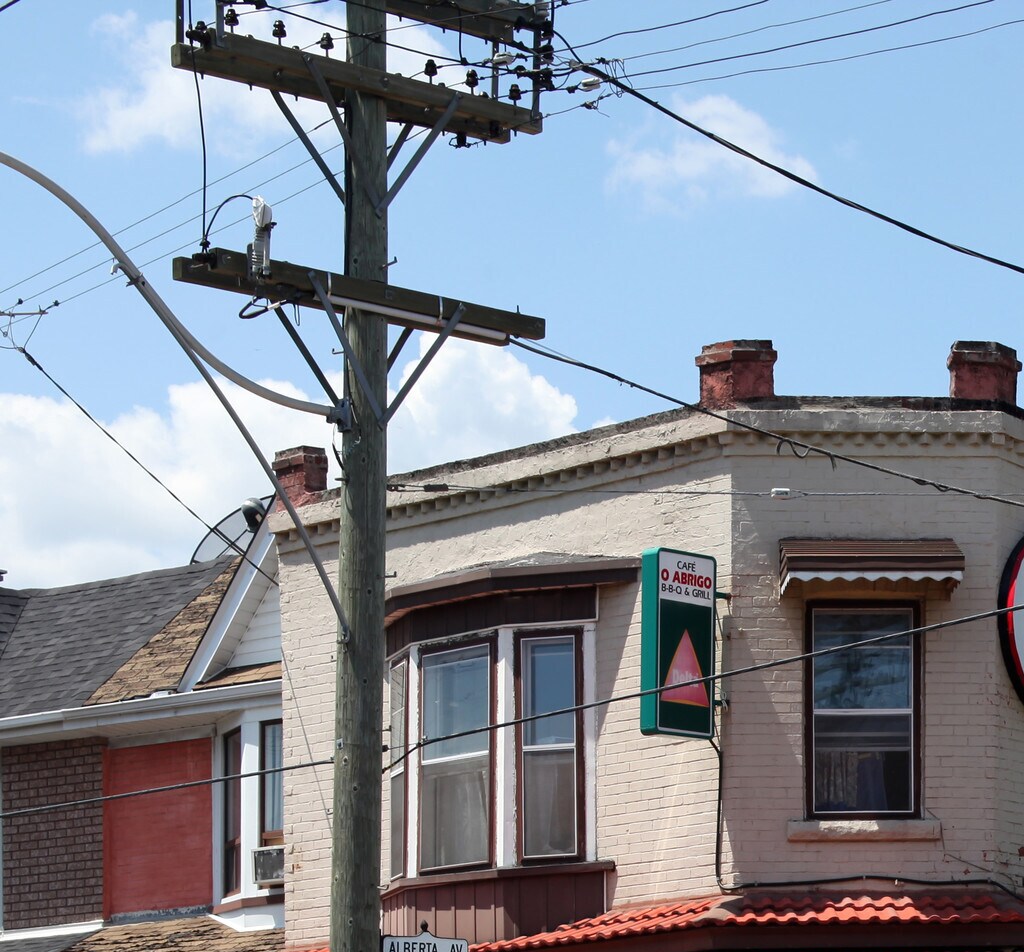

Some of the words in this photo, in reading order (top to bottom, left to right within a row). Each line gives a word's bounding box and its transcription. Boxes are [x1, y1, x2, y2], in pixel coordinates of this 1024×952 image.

[676, 560, 696, 573] CAFÉ
[661, 568, 670, 581] O
[672, 571, 712, 590] ABRIGO
[661, 583, 682, 595] B-B-Q
[684, 586, 690, 597] &
[692, 588, 711, 600] GRILL
